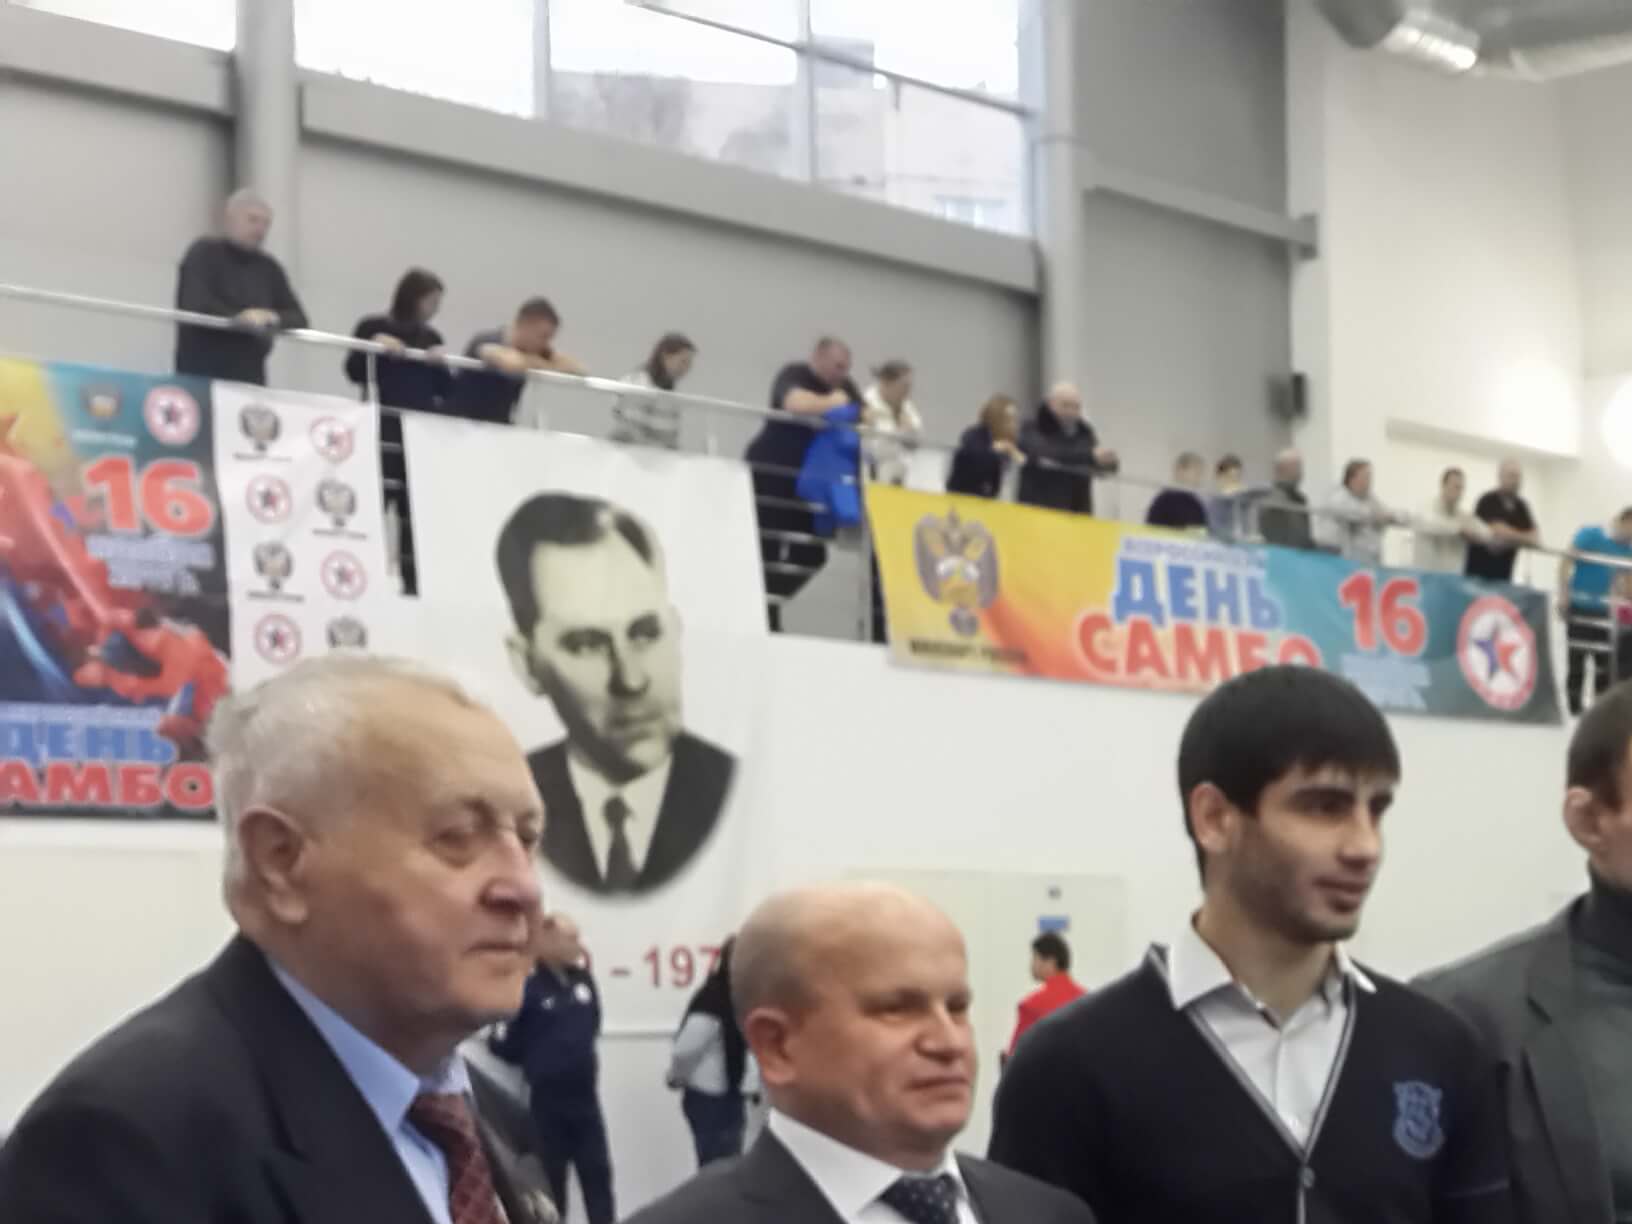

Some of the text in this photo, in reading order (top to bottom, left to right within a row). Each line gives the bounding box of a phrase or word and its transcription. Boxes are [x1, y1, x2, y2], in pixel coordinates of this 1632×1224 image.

[85, 453, 215, 538] 16
[1112, 556, 1281, 631] ДЕНЬ
[1337, 567, 1429, 658] 16
[0, 759, 214, 810] АМБО
[643, 945, 722, 988] 197
